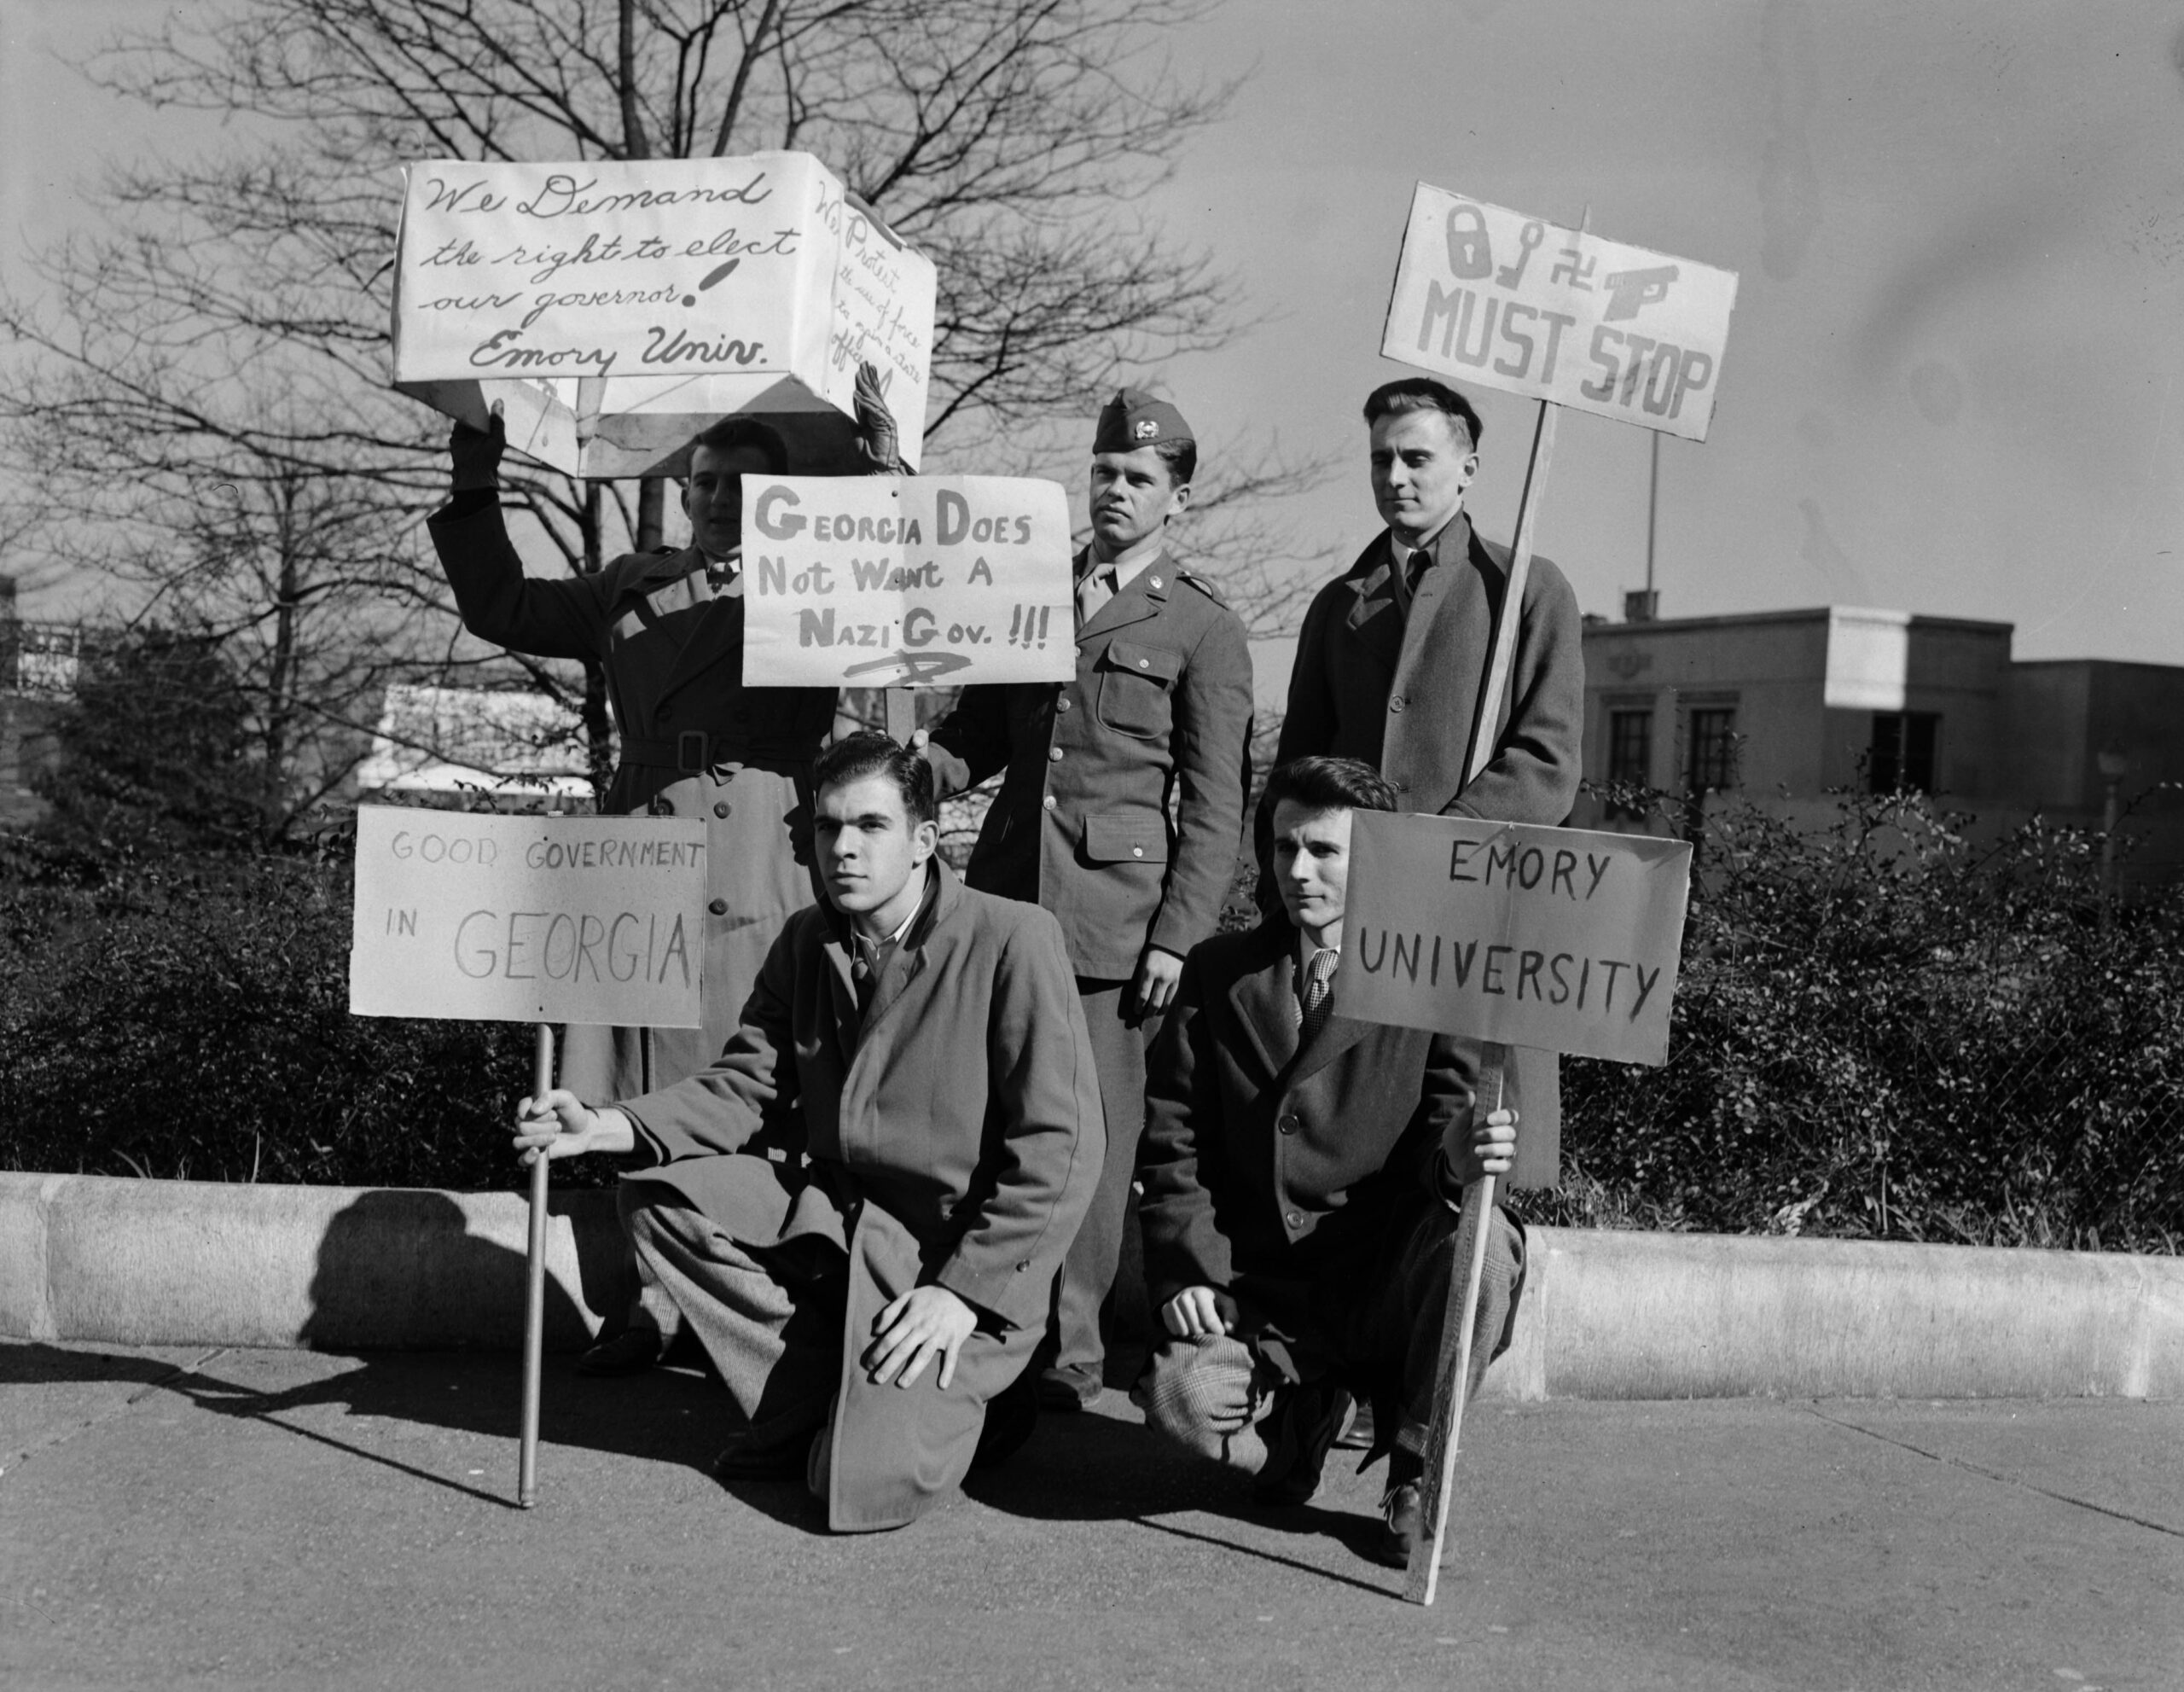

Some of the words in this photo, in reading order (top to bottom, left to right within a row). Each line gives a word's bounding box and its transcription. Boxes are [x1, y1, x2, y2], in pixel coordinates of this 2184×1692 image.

[426, 178, 508, 212] We
[515, 172, 772, 218] Demand
[419, 237, 482, 267] the
[491, 234, 623, 284] right
[621, 236, 671, 262] to
[673, 228, 801, 258] elect
[816, 180, 841, 235] We
[845, 213, 901, 294] Protest
[418, 292, 523, 310] our
[889, 305, 921, 348] force
[469, 329, 617, 376] Emory
[641, 326, 768, 365] Univ.
[1416, 278, 1577, 384] MUST
[1580, 324, 1713, 420] STOP
[754, 485, 922, 545] GEORGIA
[936, 488, 1032, 546] DOES
[967, 556, 993, 587] A
[798, 608, 890, 648] NAZI
[392, 831, 498, 865] GOOD
[526, 839, 706, 869] GOVERNMENT
[1450, 840, 1611, 901] EMORY
[386, 909, 417, 937] IN
[455, 910, 691, 989] GEORGIA
[1359, 927, 1660, 1023] UNIVERSITY
